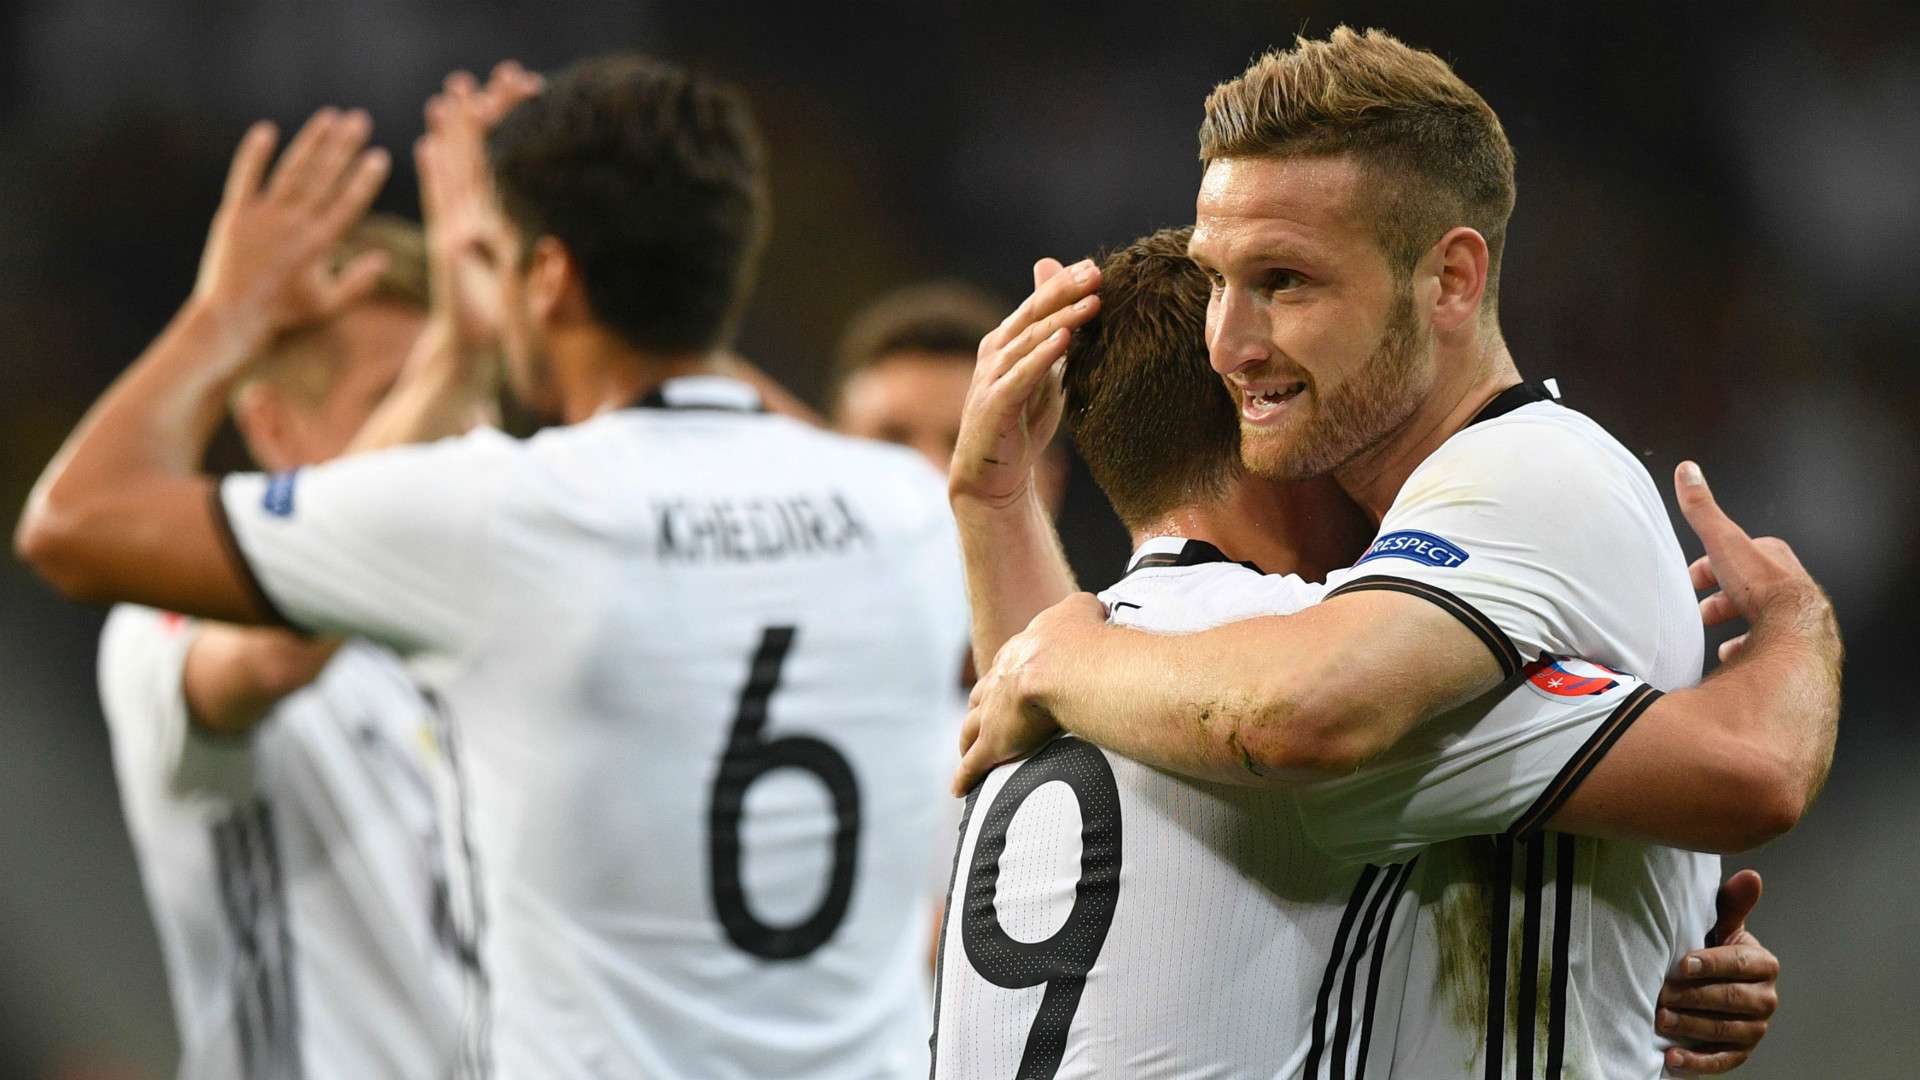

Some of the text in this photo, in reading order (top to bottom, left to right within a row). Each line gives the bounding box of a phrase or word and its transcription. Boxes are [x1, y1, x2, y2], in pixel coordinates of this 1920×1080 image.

[655, 492, 872, 563] KHEDIRA
[1370, 536, 1461, 566] RESPECT
[709, 625, 864, 961] 6
